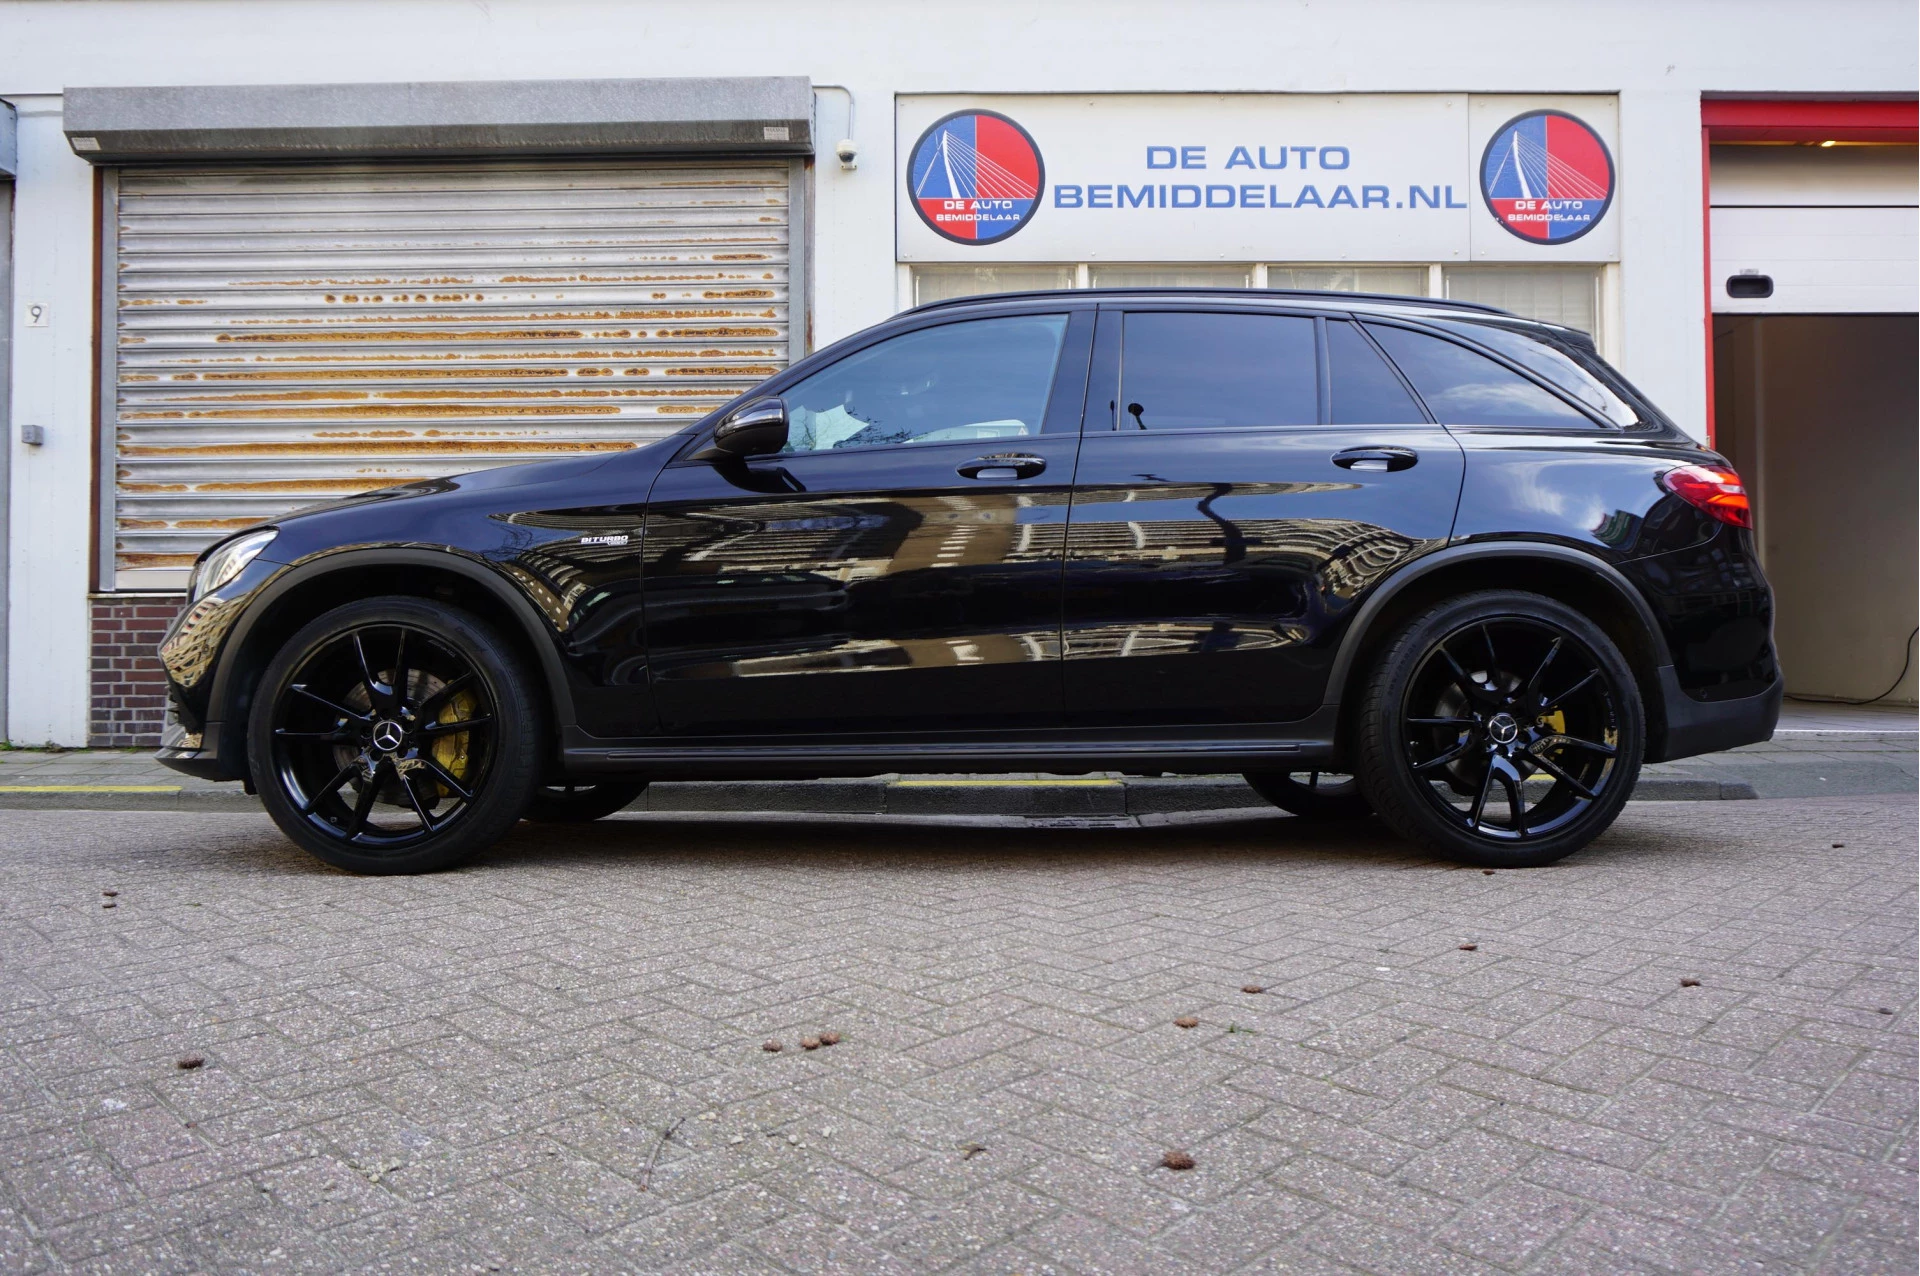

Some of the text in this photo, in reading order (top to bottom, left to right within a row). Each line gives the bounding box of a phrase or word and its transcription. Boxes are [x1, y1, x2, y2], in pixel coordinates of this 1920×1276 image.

[1146, 145, 1350, 170] DE AUTO
[1053, 183, 1467, 208] BEMIDDELAAR.NL
[943, 200, 1013, 210] DE AUTO
[1514, 200, 1583, 210] DE AUTO
[935, 213, 1020, 222] BEMIDDELAAR
[1507, 213, 1591, 222] BEMIDDELAAR
[31, 305, 42, 323] 9
[581, 535, 629, 543] BITURBO
